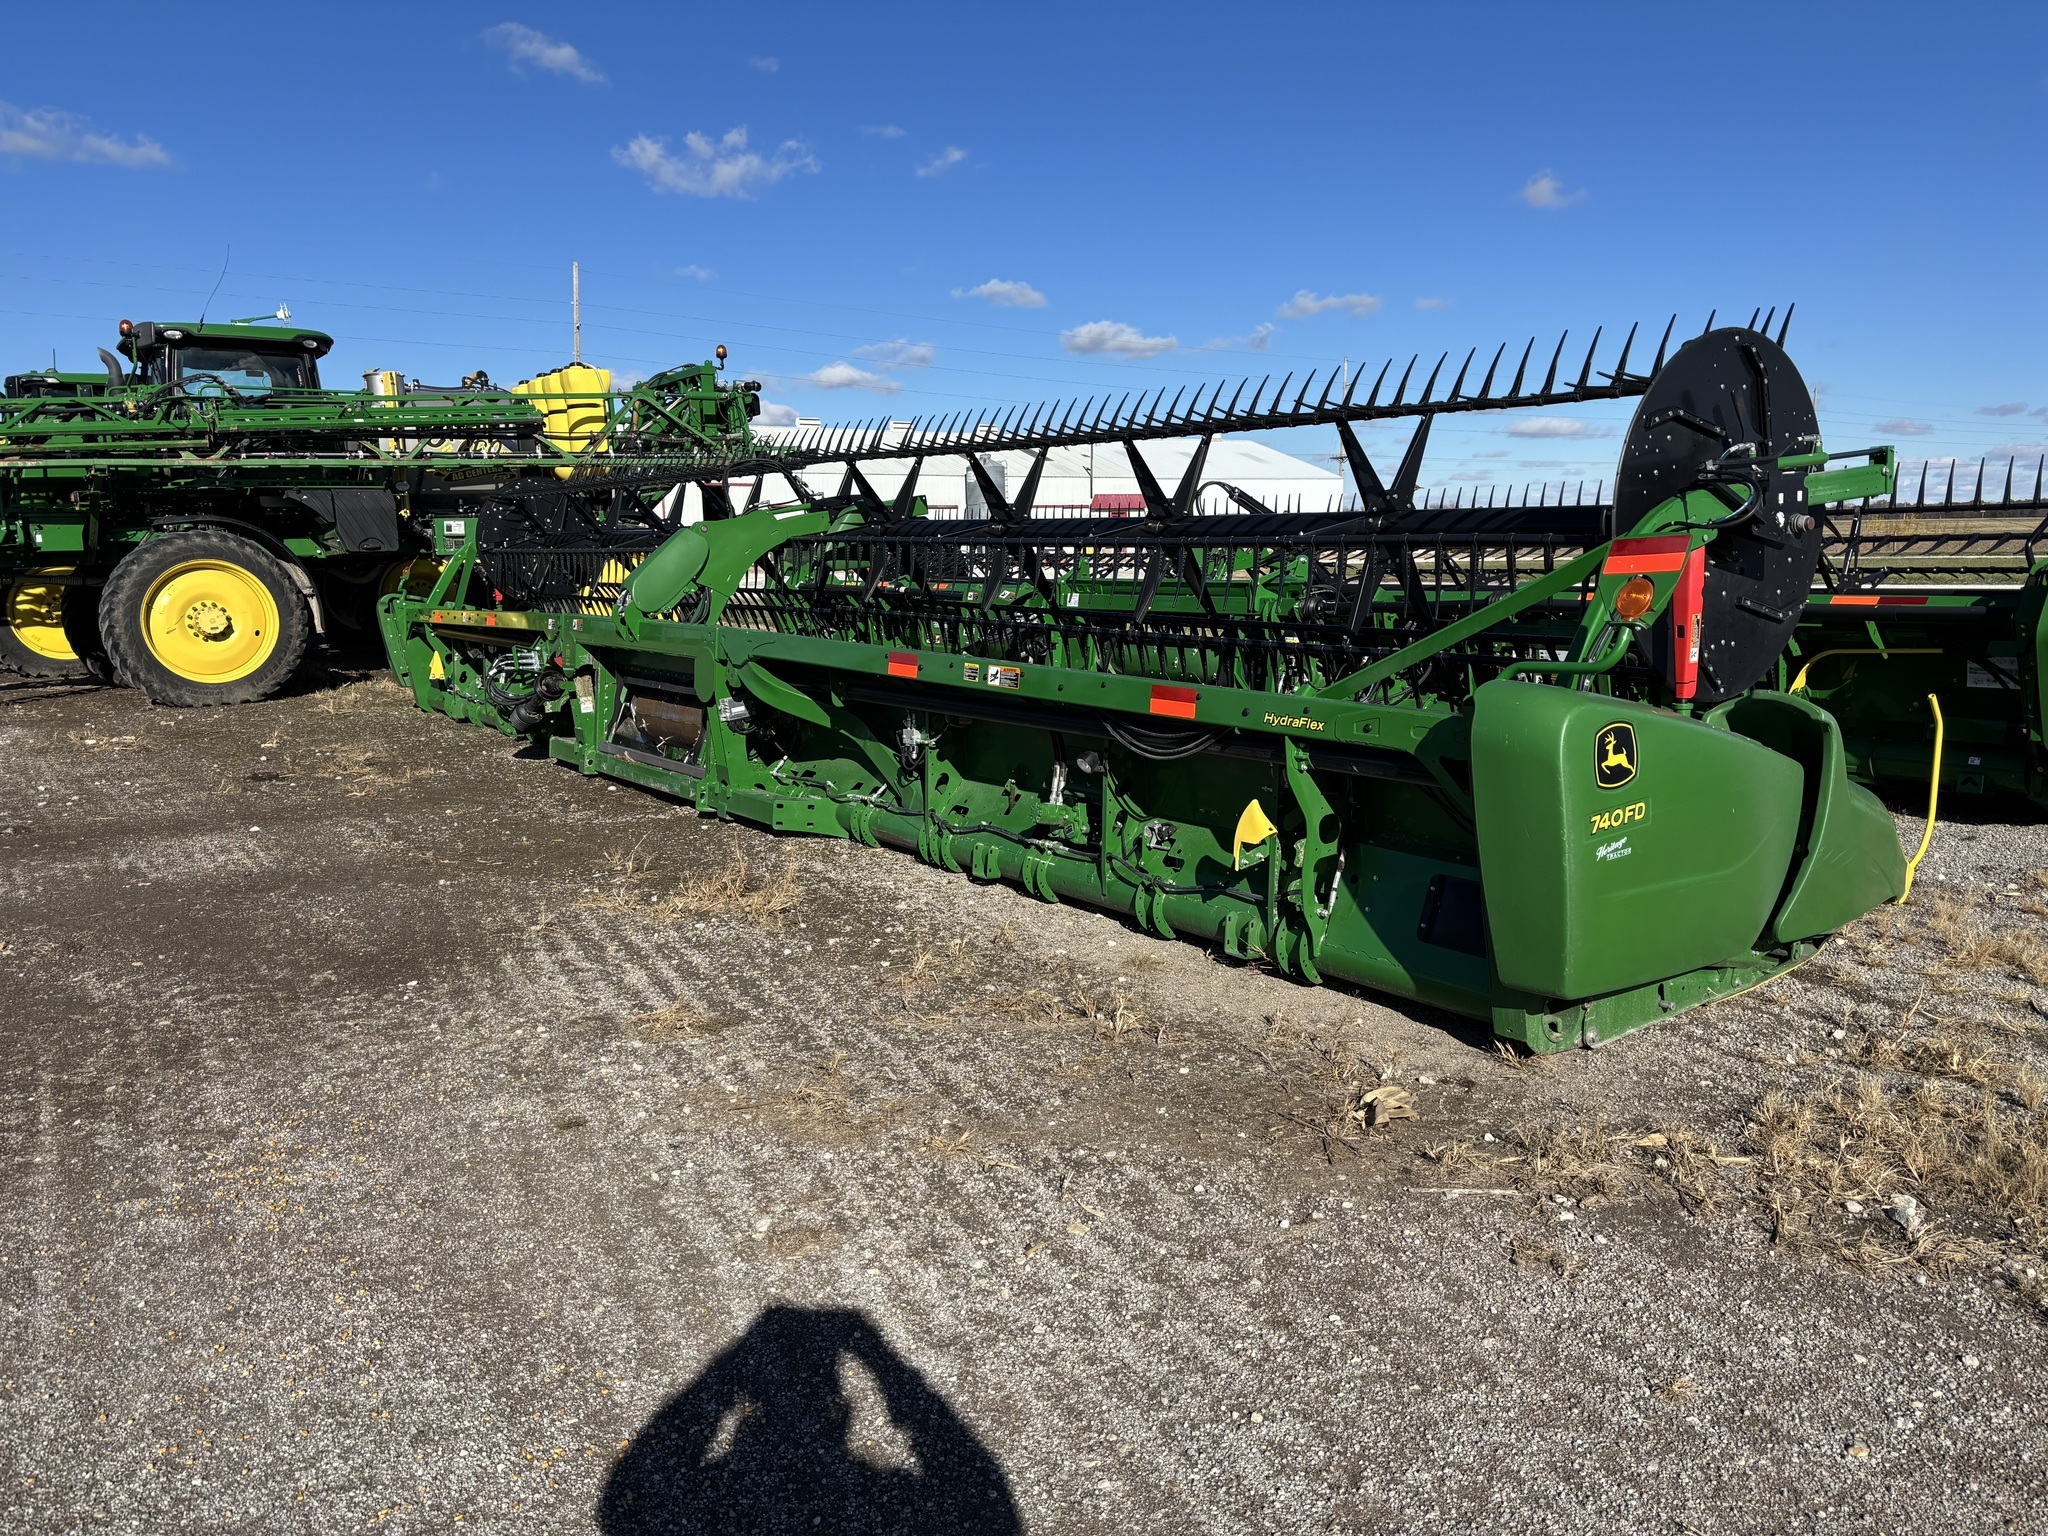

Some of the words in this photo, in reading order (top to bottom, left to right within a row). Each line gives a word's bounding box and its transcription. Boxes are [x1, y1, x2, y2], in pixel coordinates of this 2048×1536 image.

[451, 472, 464, 481] AG
[465, 466, 504, 478] CENTERS
[1263, 711, 1326, 732] HydraFlex
[1590, 801, 1646, 835] 740FD
